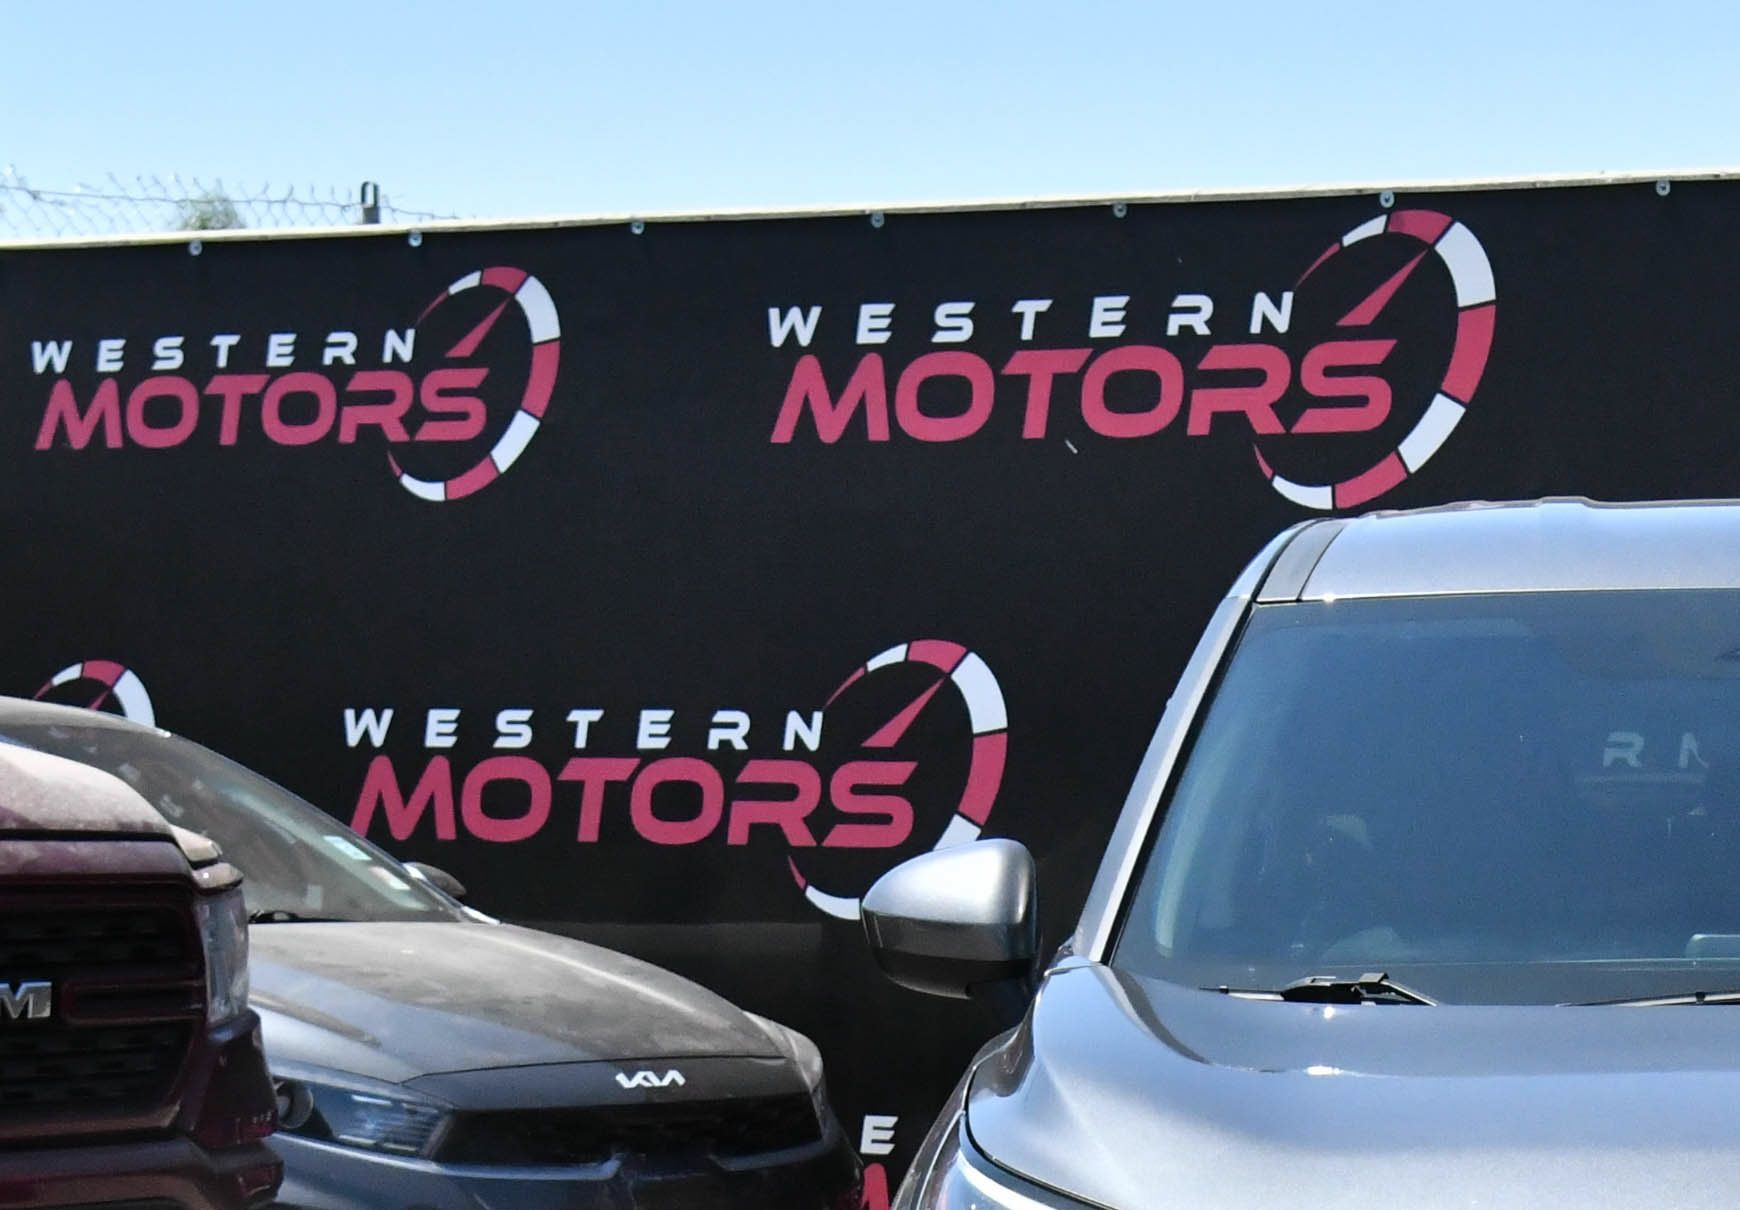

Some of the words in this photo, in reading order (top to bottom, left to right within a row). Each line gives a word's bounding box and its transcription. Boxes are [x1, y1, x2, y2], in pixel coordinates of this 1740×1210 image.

[32, 328, 415, 374] WESTERN
[768, 291, 1294, 348] WESTERN
[35, 368, 489, 450] MOTORS
[770, 339, 1397, 443] MOTORS
[344, 708, 823, 752] WESTERN
[351, 755, 918, 849] MOTORS
